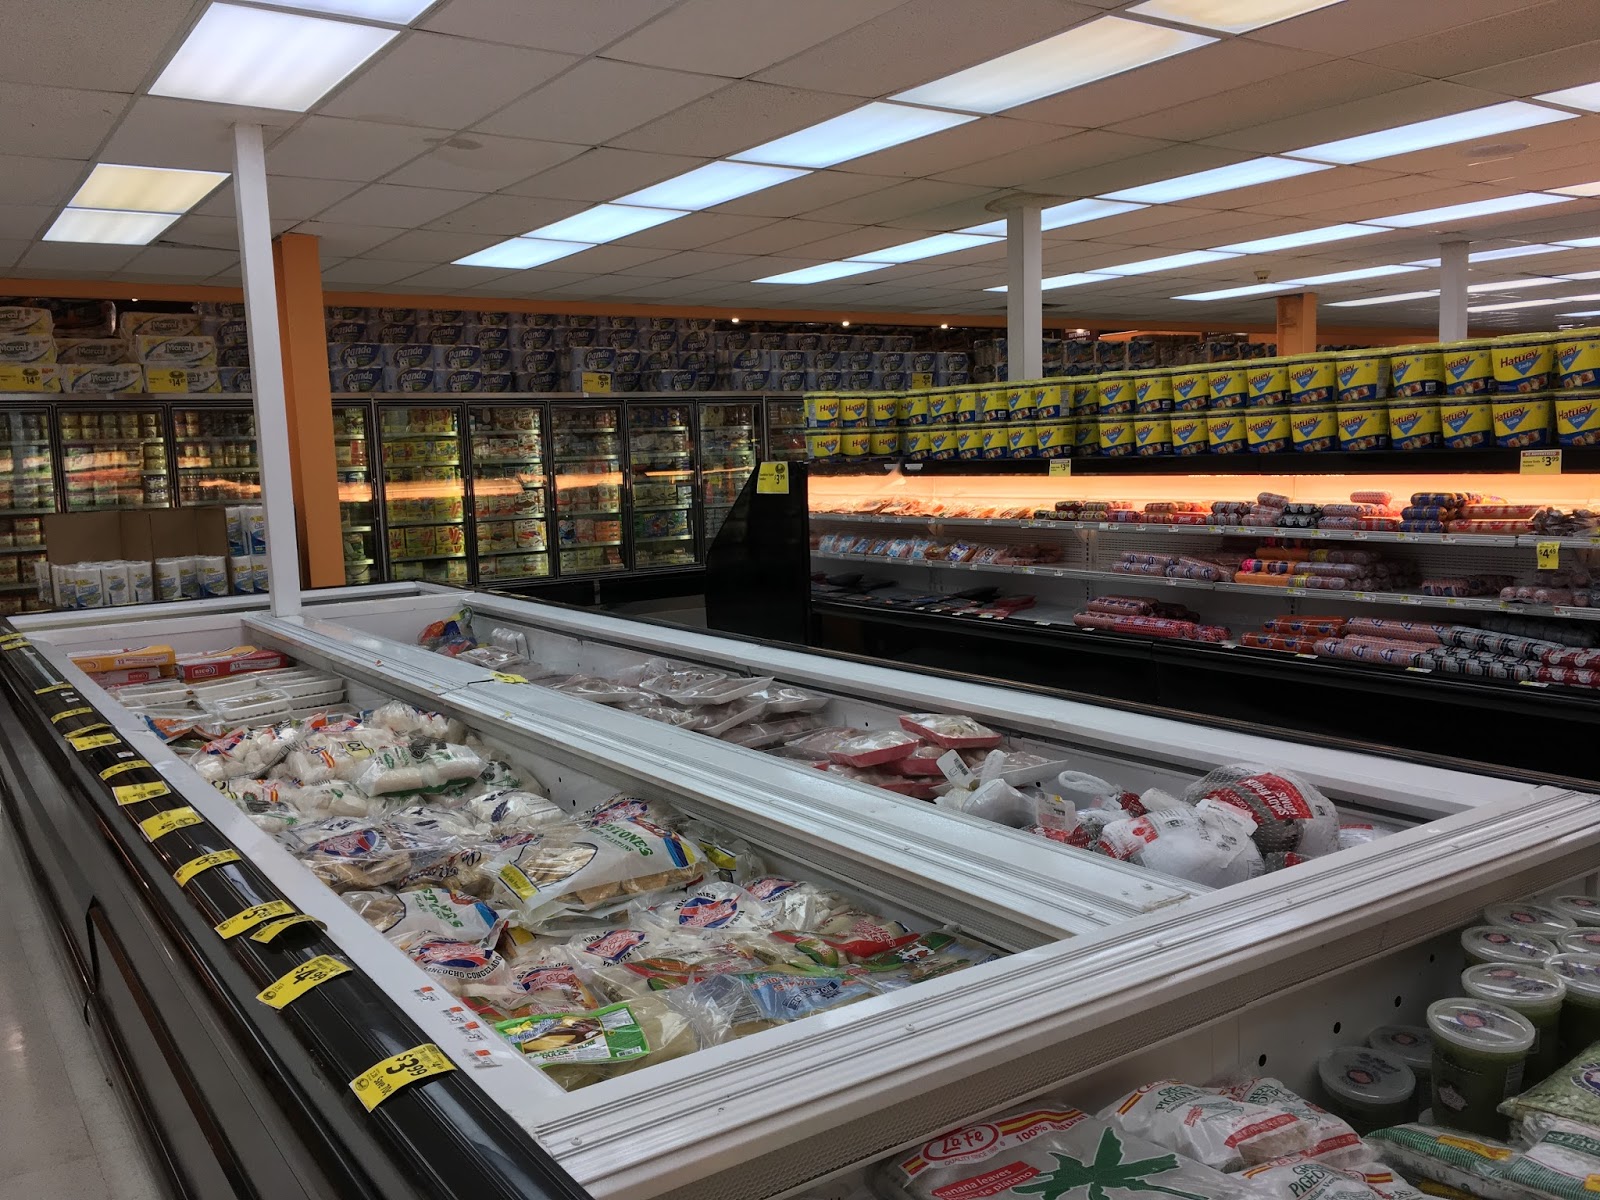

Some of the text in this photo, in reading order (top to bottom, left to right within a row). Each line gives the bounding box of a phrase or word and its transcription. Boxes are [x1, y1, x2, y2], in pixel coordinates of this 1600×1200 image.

[166, 342, 193, 353] Marcal
[1500, 350, 1538, 368] Hatuey
[1248, 371, 1271, 386] atuey
[1494, 406, 1526, 423] Hatuey
[1558, 402, 1593, 422] Hatuey
[1292, 416, 1319, 431] Hatuey
[1265, 795, 1290, 817] SHADY
[1276, 791, 1300, 816] FARMS
[600, 822, 654, 858] OSTONES
[466, 954, 503, 980] CONGELADO
[941, 1129, 985, 1155] La Fe
[1015, 1123, 1049, 1144] 100%
[934, 1167, 1013, 1199] banana leaves
[978, 1185, 994, 1199] de
[992, 1169, 1033, 1193] plátano
[1288, 1169, 1326, 1198] PIGEO
